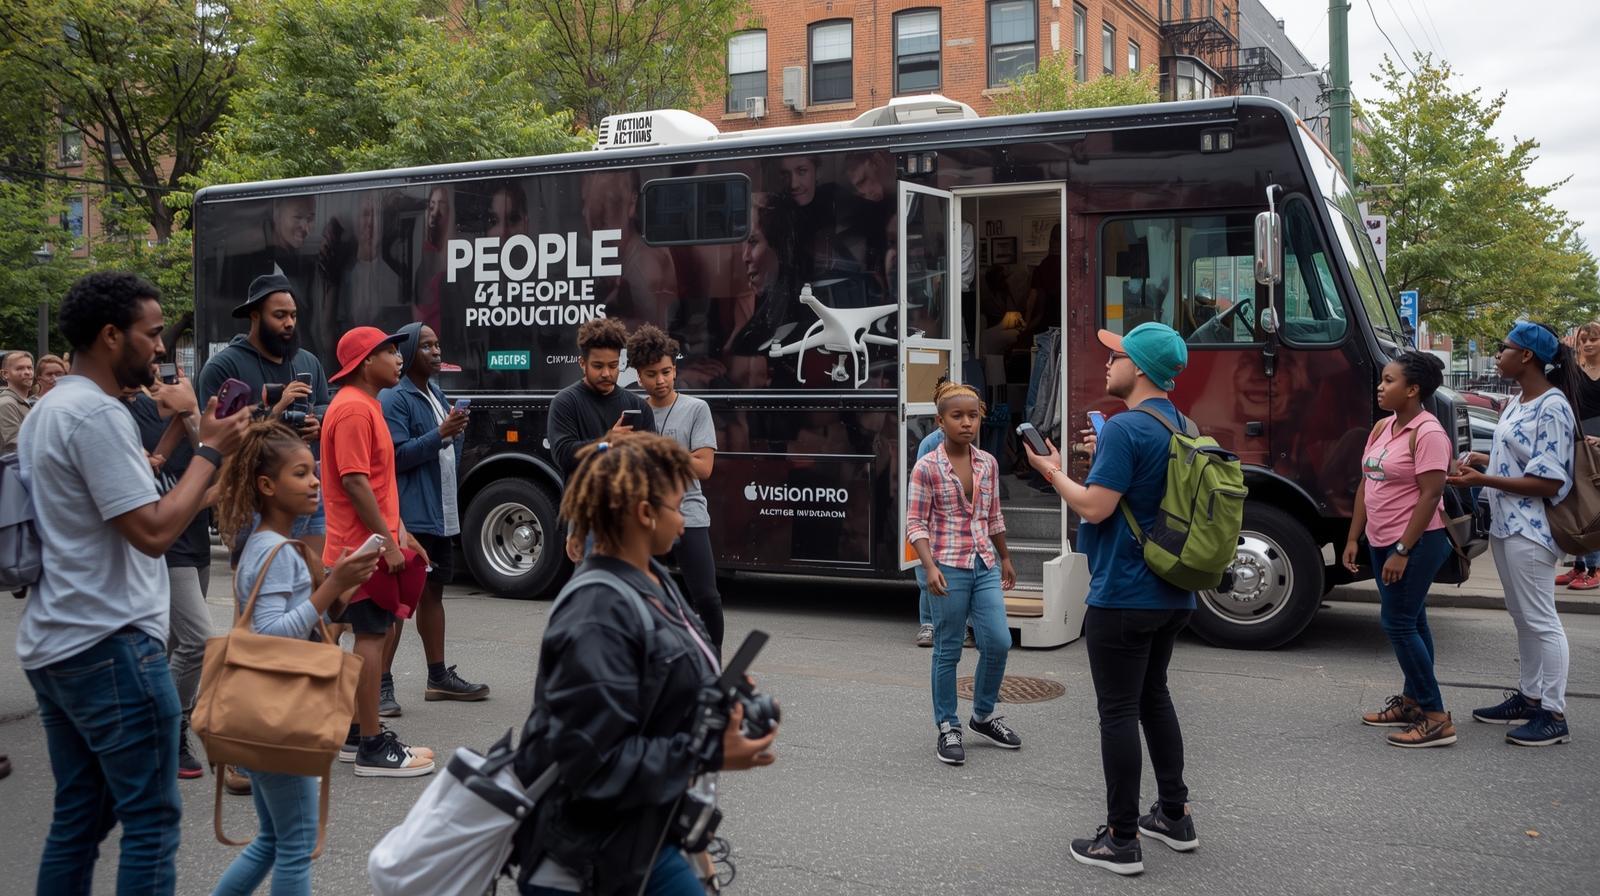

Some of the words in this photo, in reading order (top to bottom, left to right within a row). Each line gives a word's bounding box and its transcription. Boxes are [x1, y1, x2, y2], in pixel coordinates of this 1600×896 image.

[447, 228, 622, 283] PEOPLE
[507, 279, 595, 302] PEOPLE
[465, 303, 607, 326] PRODUCTIONS
[815, 487, 849, 503] PRO
